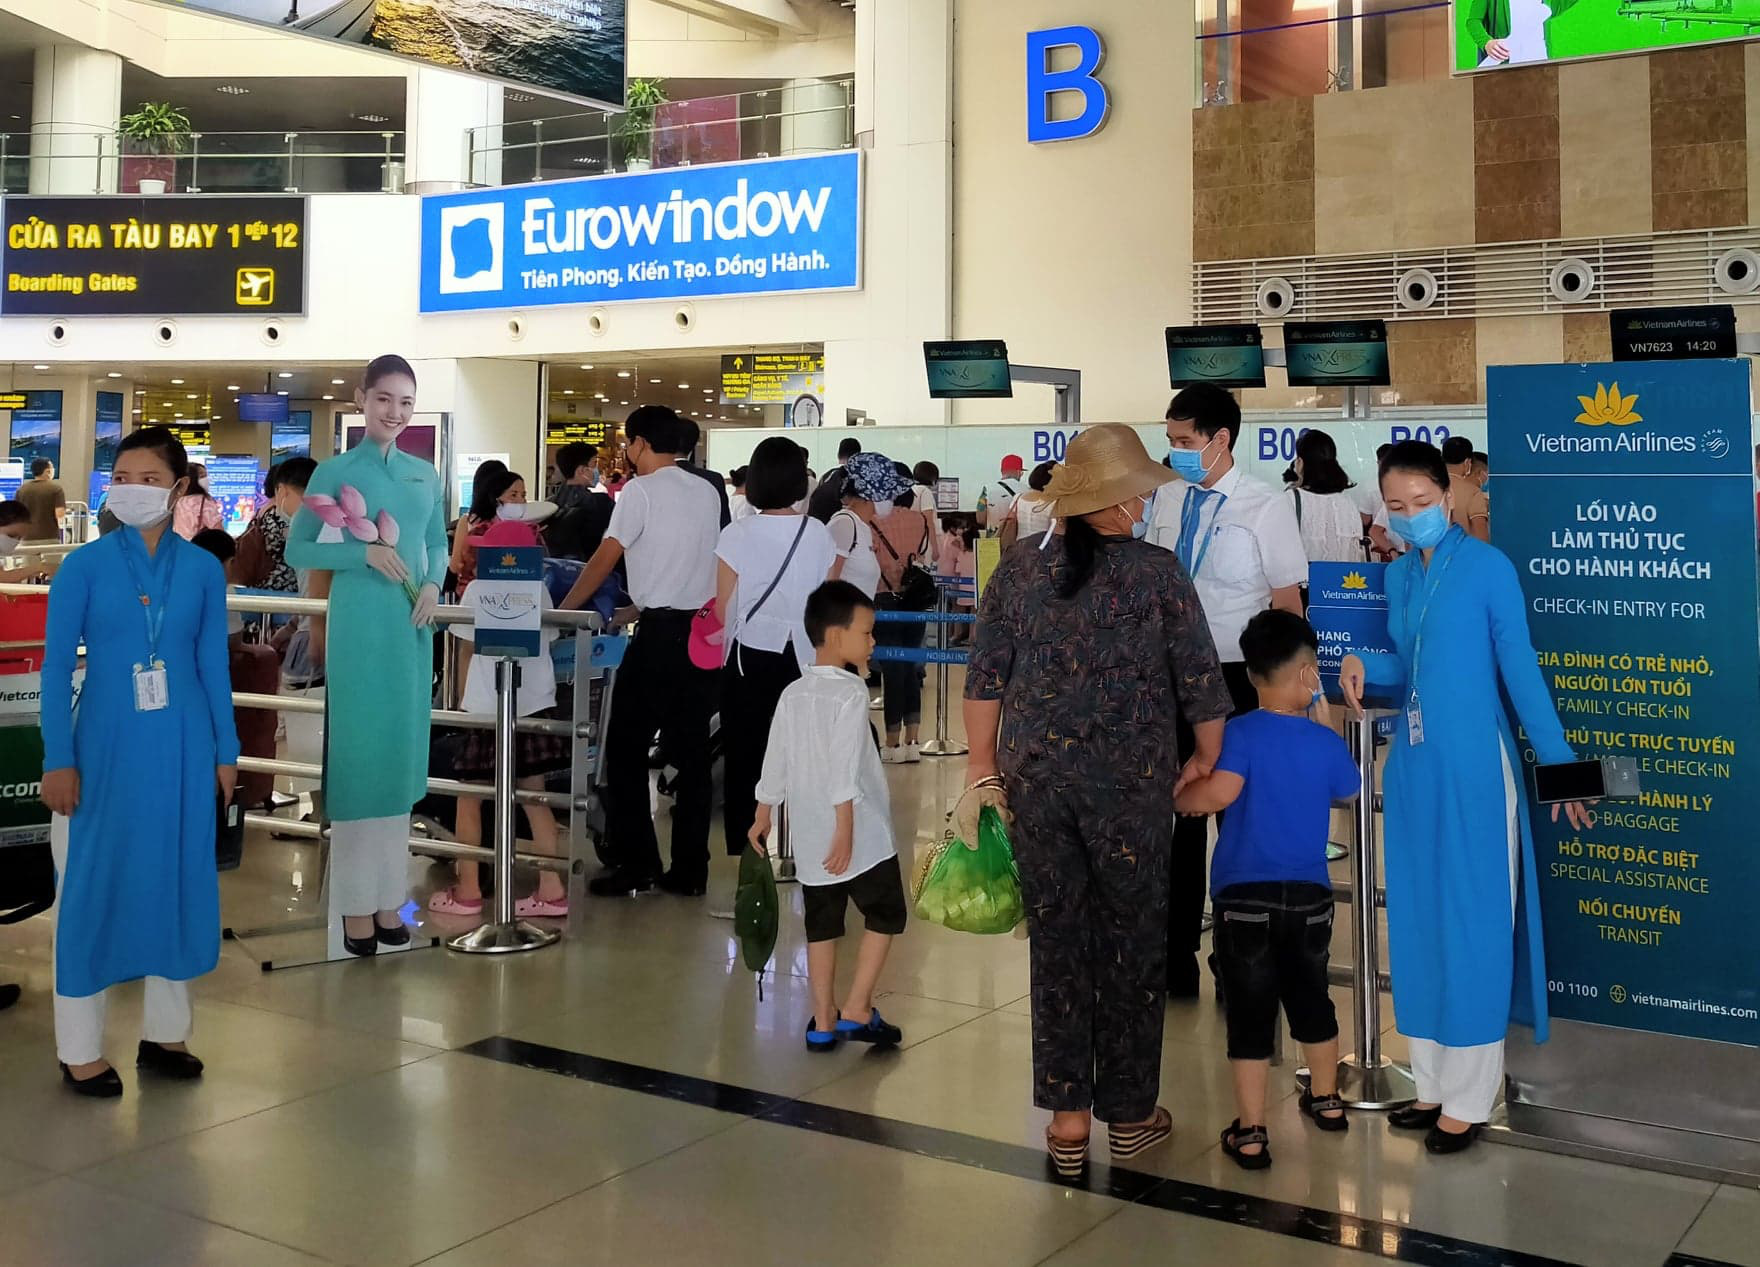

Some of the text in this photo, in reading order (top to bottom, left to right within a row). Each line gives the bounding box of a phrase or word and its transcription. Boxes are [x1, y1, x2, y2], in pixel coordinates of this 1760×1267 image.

[1026, 24, 1107, 144] B
[521, 178, 832, 256] Eurowindow
[8, 216, 58, 249] CỬA
[67, 224, 101, 248] RA
[110, 218, 160, 248] TÀU
[169, 223, 218, 248] BAY
[227, 223, 239, 248] 1
[271, 223, 297, 248] 12
[520, 249, 830, 289] Tiên Phong. Kiến Tạo. Đồng Hành.
[8, 272, 137, 294] Boarding Gates
[1630, 341, 1717, 353] VN7623 14:20
[1034, 430, 1078, 462] B0
[1259, 427, 1310, 461] B0
[1576, 499, 1657, 522] LỐI VÀO
[1551, 527, 1686, 555] LÀM THỦ TỤC
[1529, 556, 1711, 580] CHO HÀNH KHÁCH
[1533, 597, 1705, 619] CHECK-IN ENTRY FOR
[1563, 650, 1605, 669] ĐÌNH
[1608, 652, 1632, 670] CÓ
[1635, 653, 1667, 672] TRẺ
[1670, 655, 1714, 677] NHỎ,
[1554, 674, 1692, 697] NGƯỜI LỚN TUỔI
[1557, 697, 1690, 720] FAMILY CHECK-IN
[1565, 725, 1735, 756] HỦ TỤC TRỰC TUYẾN
[1655, 759, 1730, 779] CHECK-IN
[1639, 789, 1713, 812] HÀNH LÝ
[1558, 836, 1699, 871] HỖ TRỢ ĐẶC BIỆT
[1551, 862, 1709, 894] SPECIAL ASSISTANCE
[1578, 897, 1681, 926] NỐI CHUYẾN
[1597, 924, 1663, 946] TRANSIT
[1569, 983, 1598, 998] 1100
[1631, 992, 1758, 1020] vietnamairlines.com
